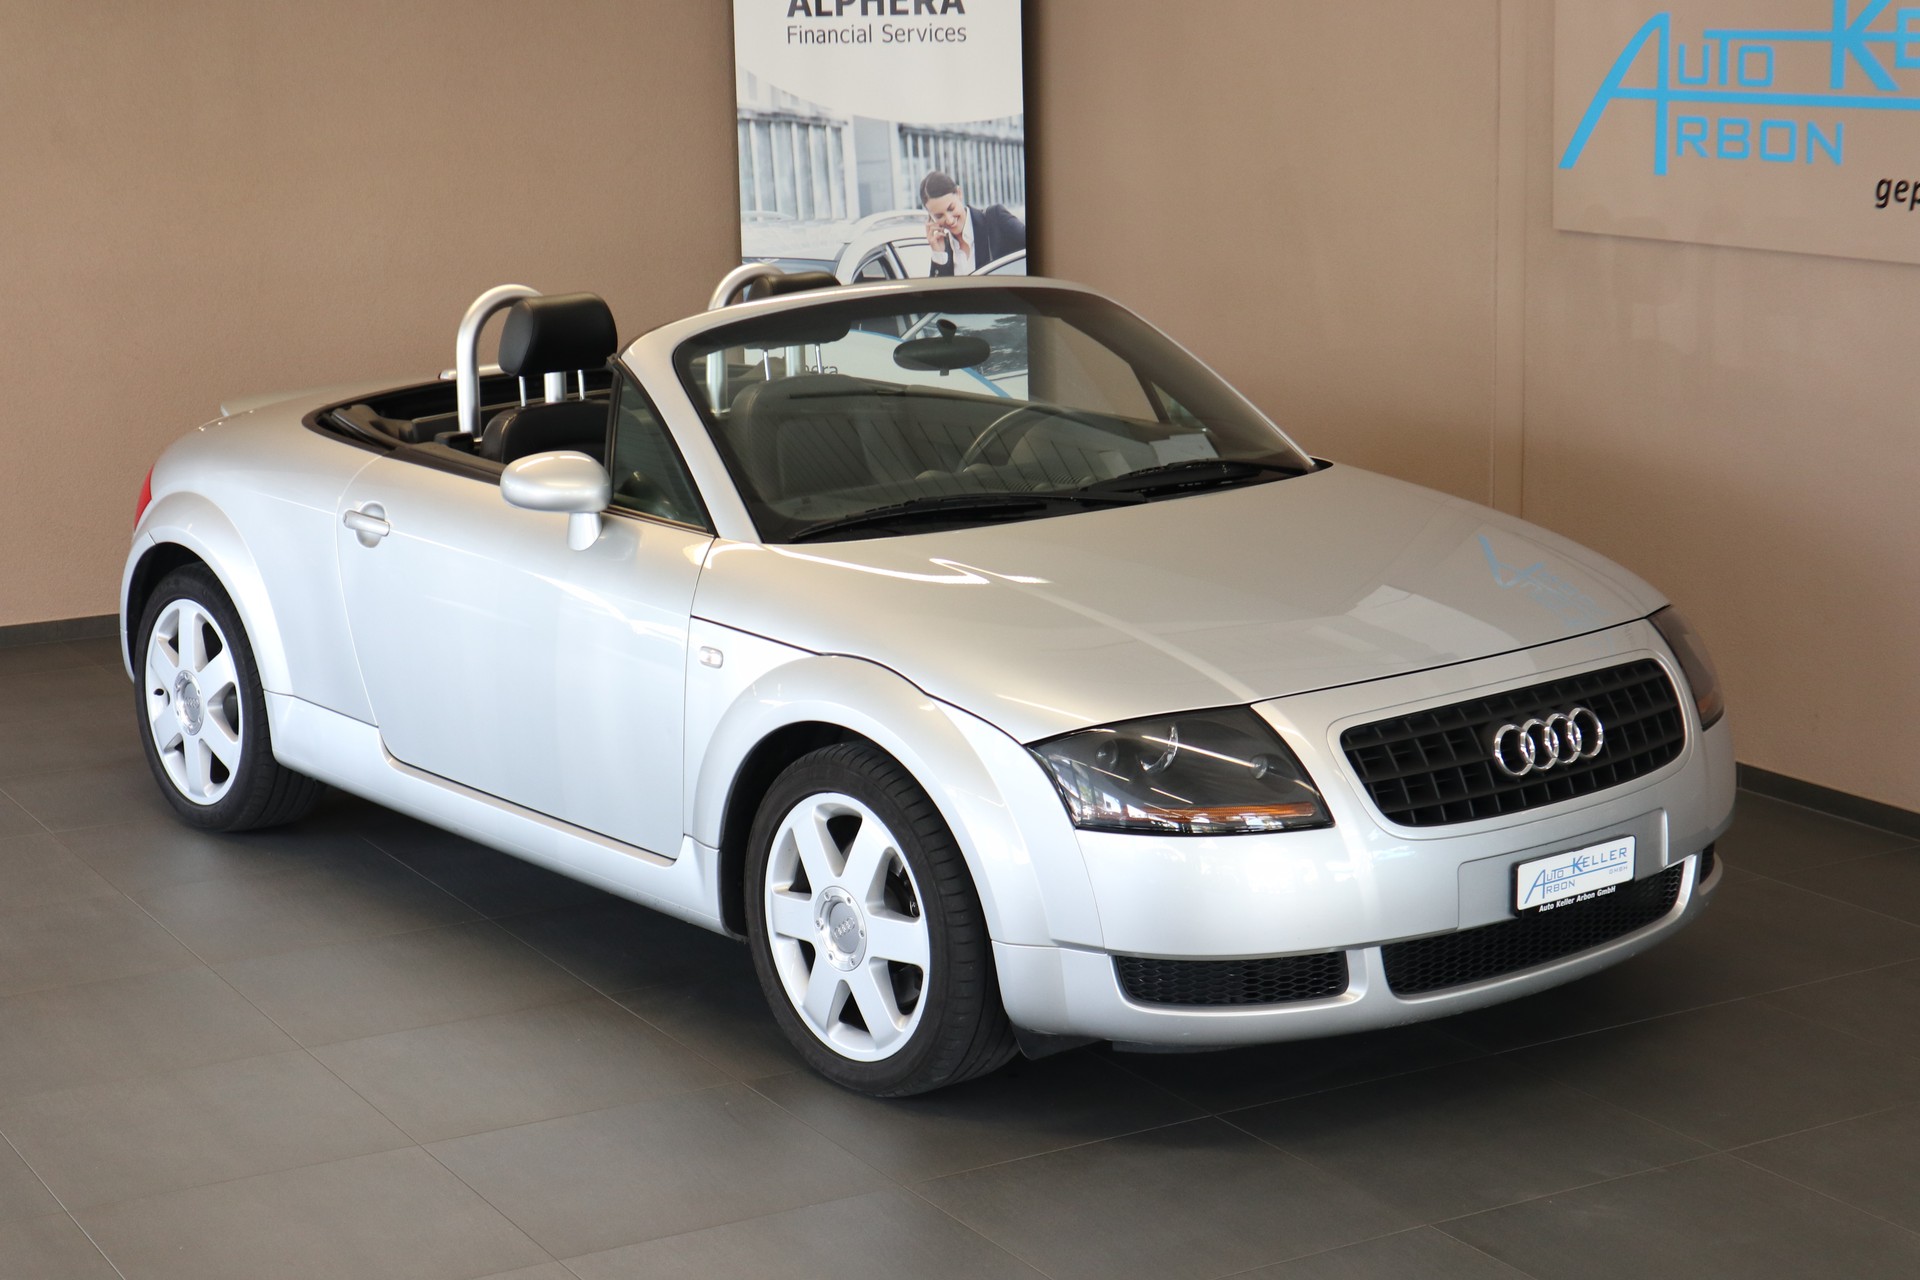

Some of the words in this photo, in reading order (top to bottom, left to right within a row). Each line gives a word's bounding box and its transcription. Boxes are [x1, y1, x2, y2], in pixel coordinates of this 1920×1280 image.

[787, 0, 966, 17] ALPHERA
[787, 24, 872, 44] Financial
[882, 23, 967, 43] Services
[1558, 11, 1775, 176] AUTO
[1524, 869, 1564, 904] AUTO
[1573, 847, 1627, 874] KELLER
[1539, 904, 1554, 912] Auto
[1556, 898, 1575, 908] Keller
[1576, 892, 1595, 902] Arbon
[1597, 886, 1616, 896] GmbH
